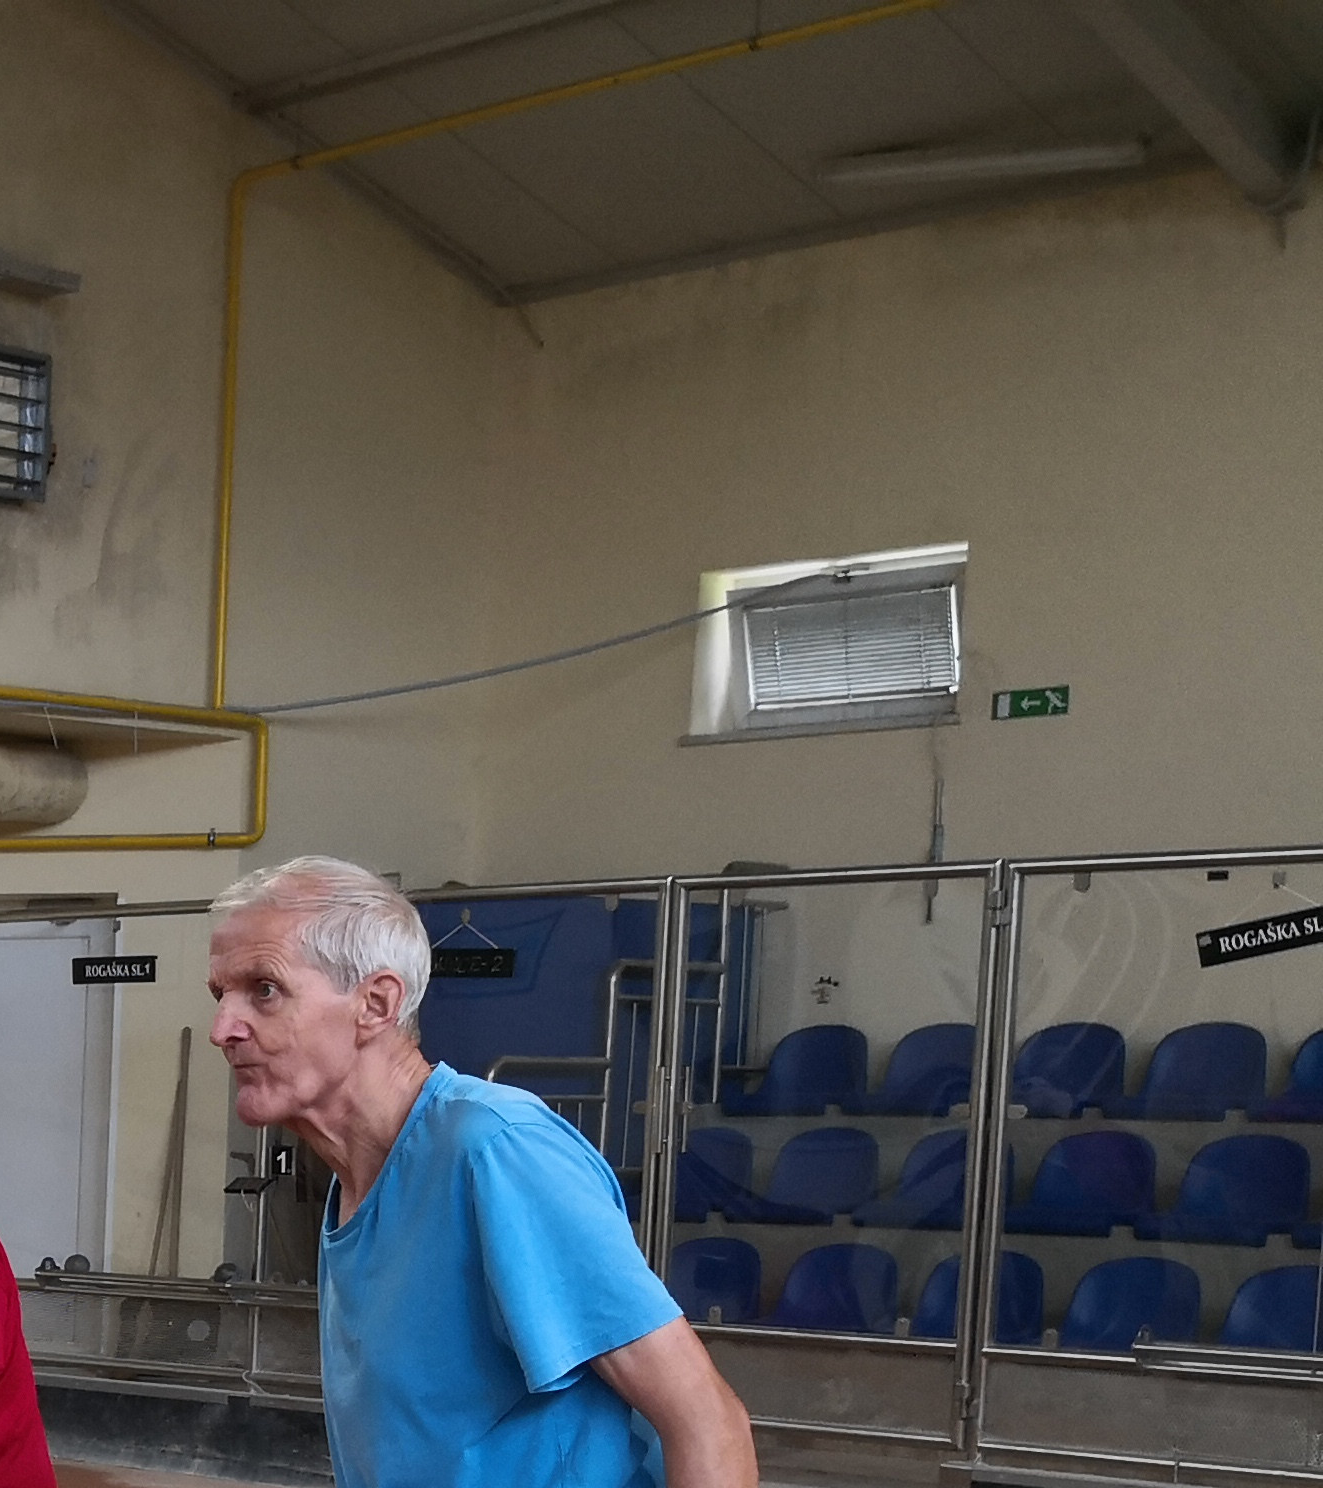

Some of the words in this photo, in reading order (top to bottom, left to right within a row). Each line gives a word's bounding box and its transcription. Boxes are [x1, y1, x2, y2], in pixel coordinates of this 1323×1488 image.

[1219, 921, 1301, 954] ROGAŠKA
[85, 961, 129, 977] ROGAŠKA
[276, 1150, 287, 1174] 1
